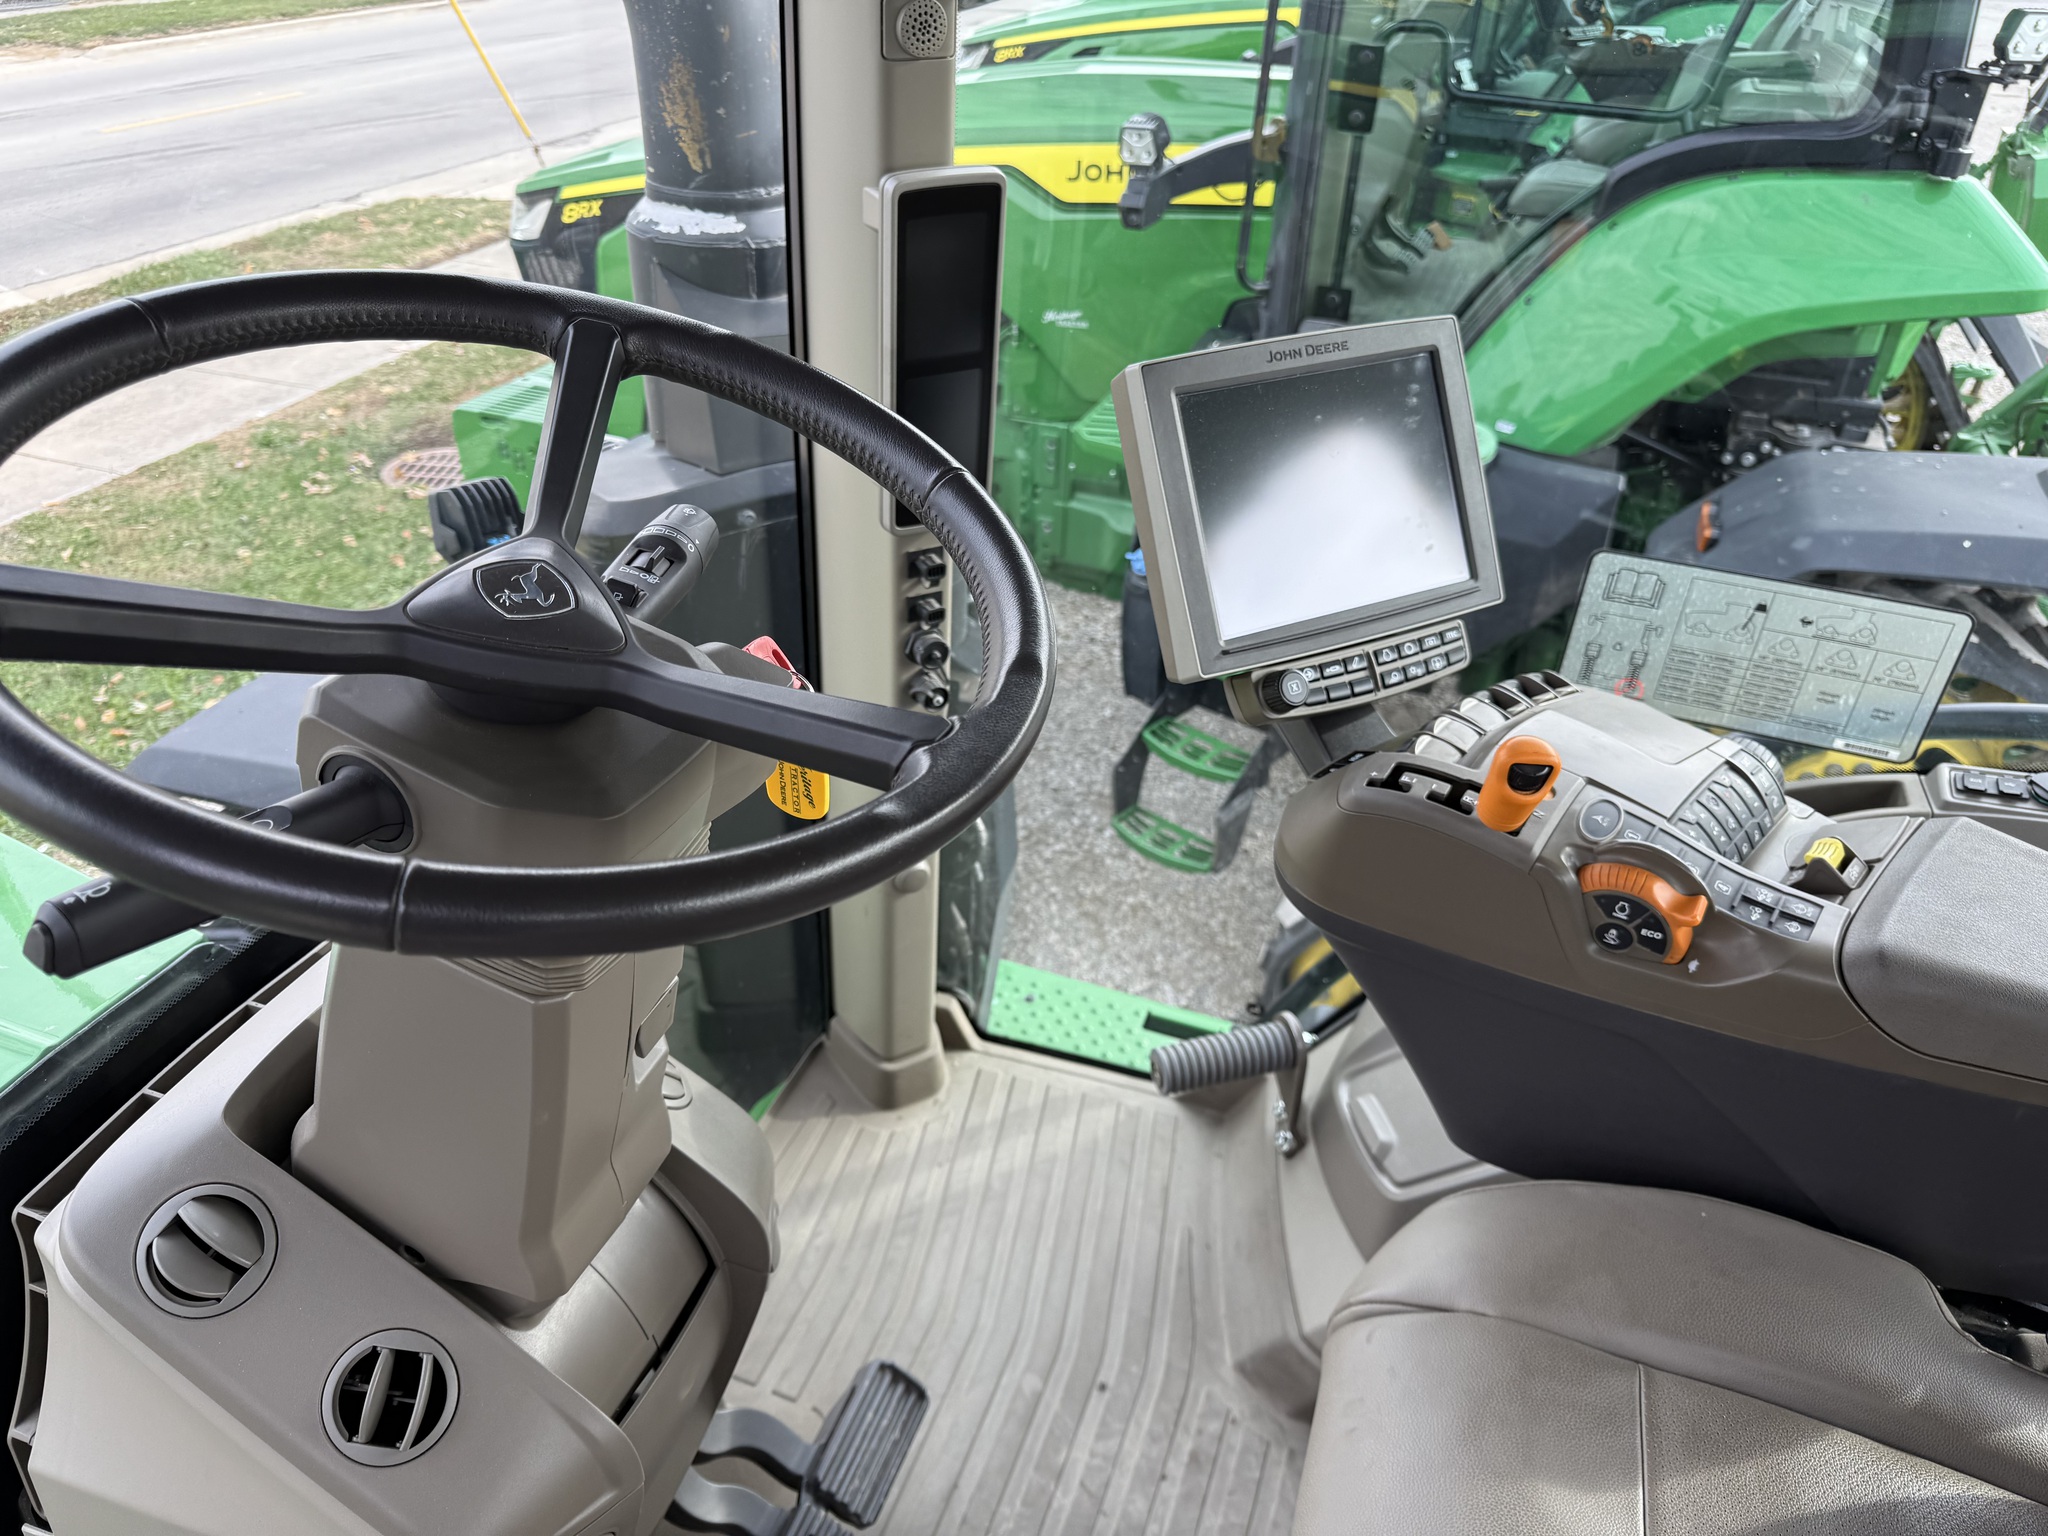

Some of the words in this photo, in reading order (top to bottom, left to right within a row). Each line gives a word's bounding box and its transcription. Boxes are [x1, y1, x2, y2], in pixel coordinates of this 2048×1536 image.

[561, 199, 603, 224] 8RX
[1266, 347, 1302, 363] JOHN
[1305, 340, 1349, 357] DEERE
[791, 767, 800, 814] TRACTOR
[798, 765, 816, 809] ritage
[1640, 928, 1663, 940] ECO
